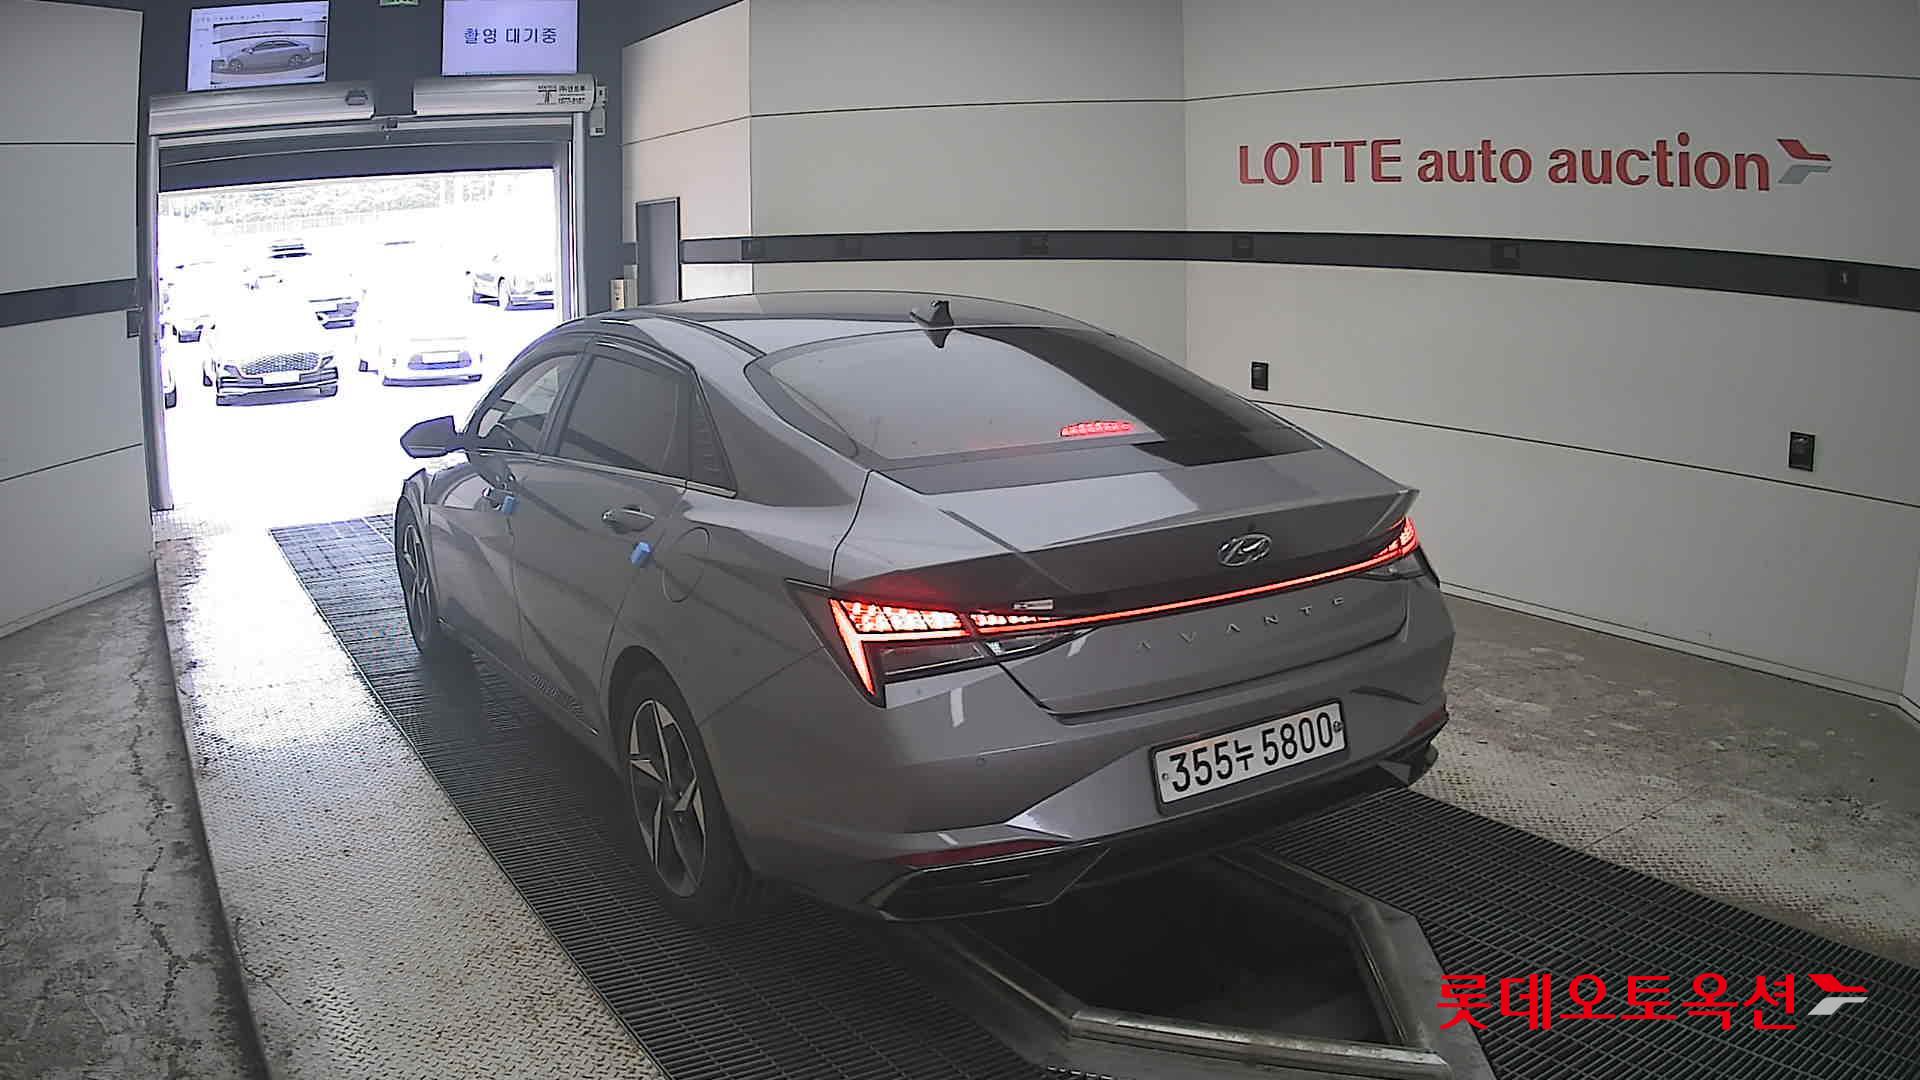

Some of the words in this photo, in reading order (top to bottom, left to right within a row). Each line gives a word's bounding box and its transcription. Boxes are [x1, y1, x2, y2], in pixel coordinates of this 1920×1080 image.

[464, 27, 497, 45] 촬영
[504, 27, 558, 44] 대기중
[1239, 138, 1402, 185] LOTTE
[1417, 139, 1533, 184] auto
[1549, 131, 1770, 191] auction
[1169, 739, 1255, 793] 355누
[1261, 711, 1334, 767] 5800
